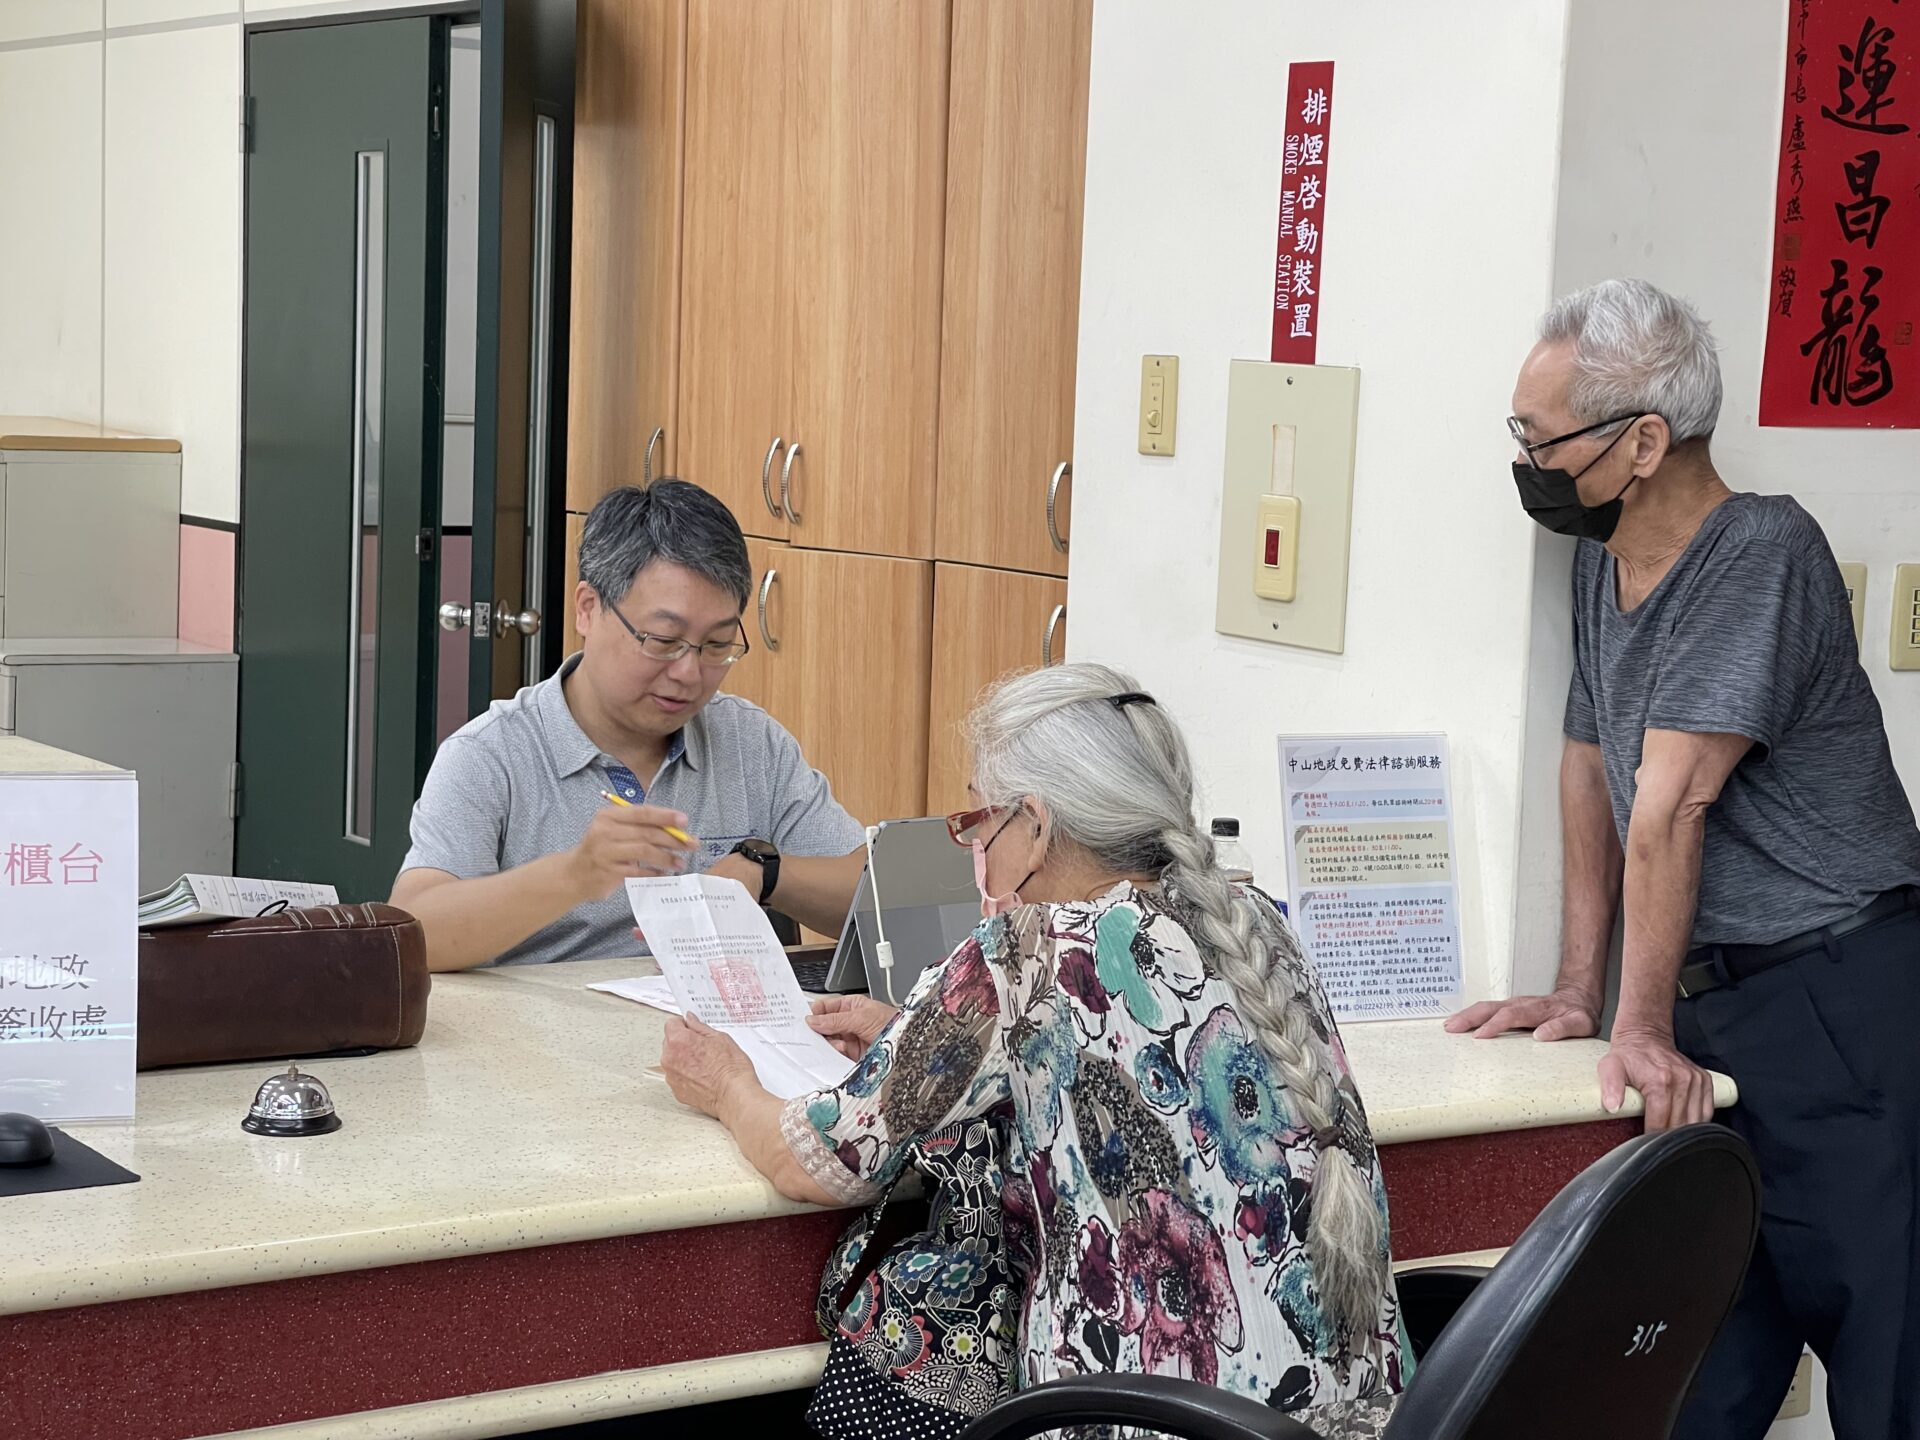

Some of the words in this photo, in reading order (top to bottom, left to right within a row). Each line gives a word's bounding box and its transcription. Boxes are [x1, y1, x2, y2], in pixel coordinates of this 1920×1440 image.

[1284, 134, 1299, 175] SMOKE
[1280, 190, 1295, 239] MANUAL
[1801, 0, 1911, 407] 運昌龍
[1276, 254, 1292, 310] STATION
[1288, 755, 1442, 773] 中山地政免費法律諮詢服務
[0, 842, 104, 886] 櫃台
[0, 953, 91, 990] 地政
[1625, 1320, 1668, 1356] 315
